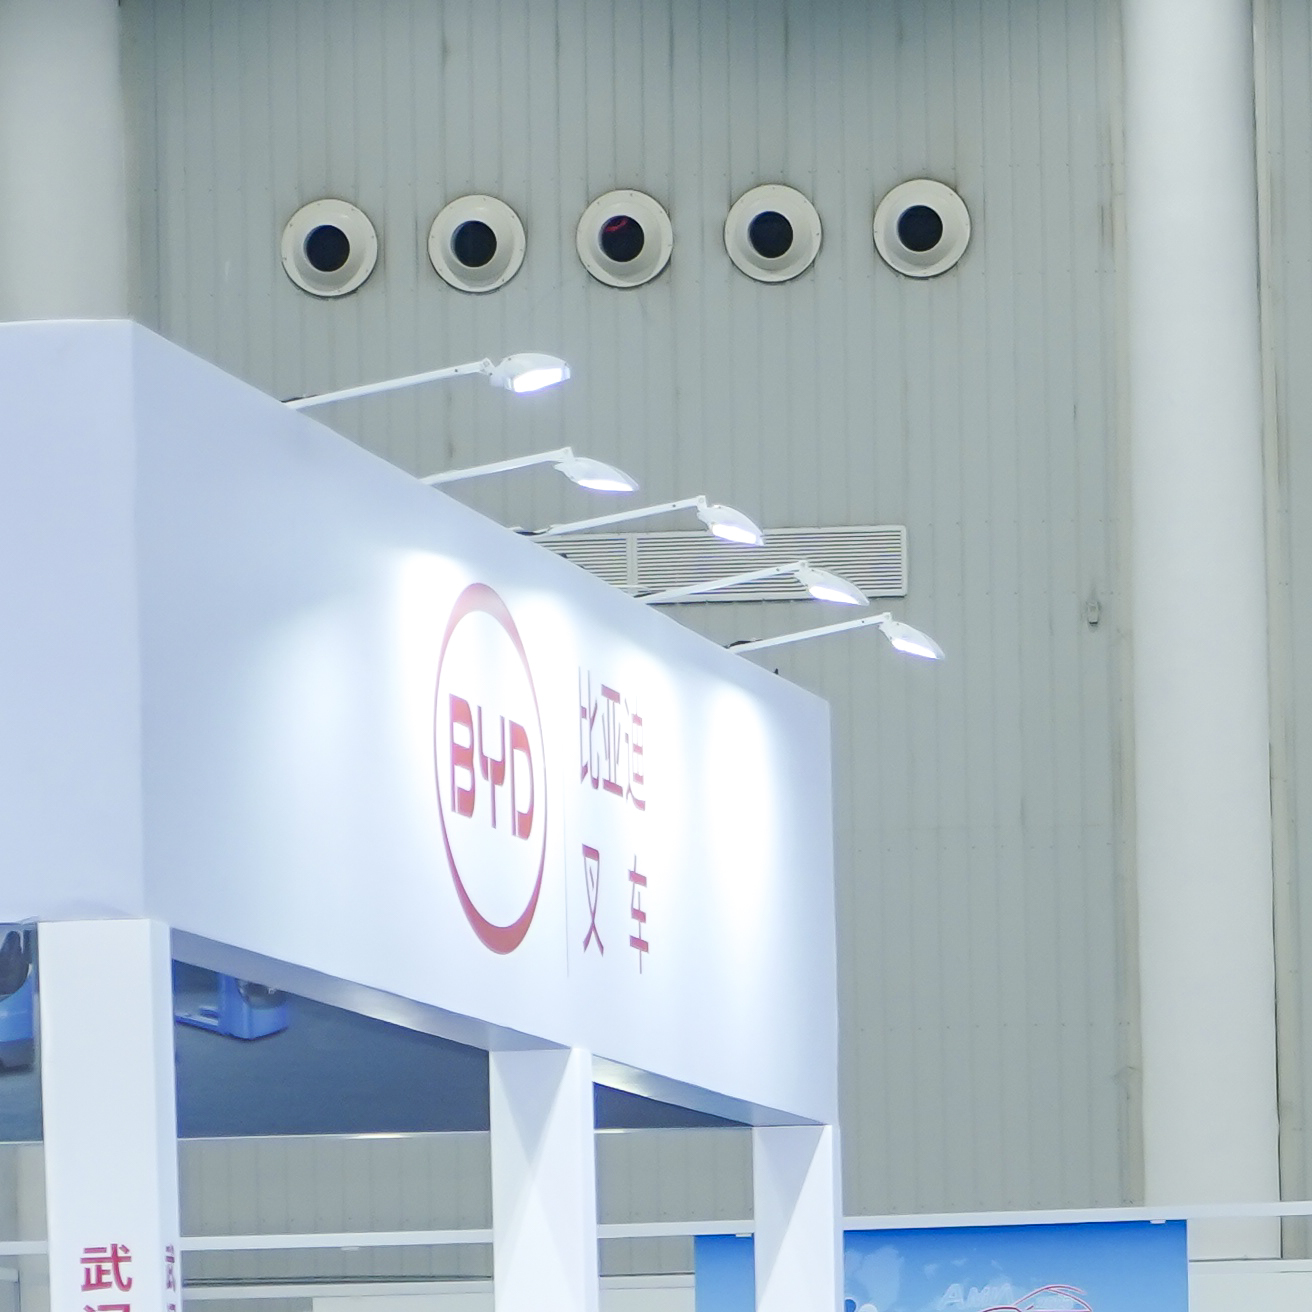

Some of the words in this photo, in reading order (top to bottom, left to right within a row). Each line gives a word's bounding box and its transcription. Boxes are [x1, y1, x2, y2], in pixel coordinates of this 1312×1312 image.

[449, 693, 535, 841] BYD
[578, 666, 647, 812] 比亚迪
[581, 843, 650, 975] 叉车
